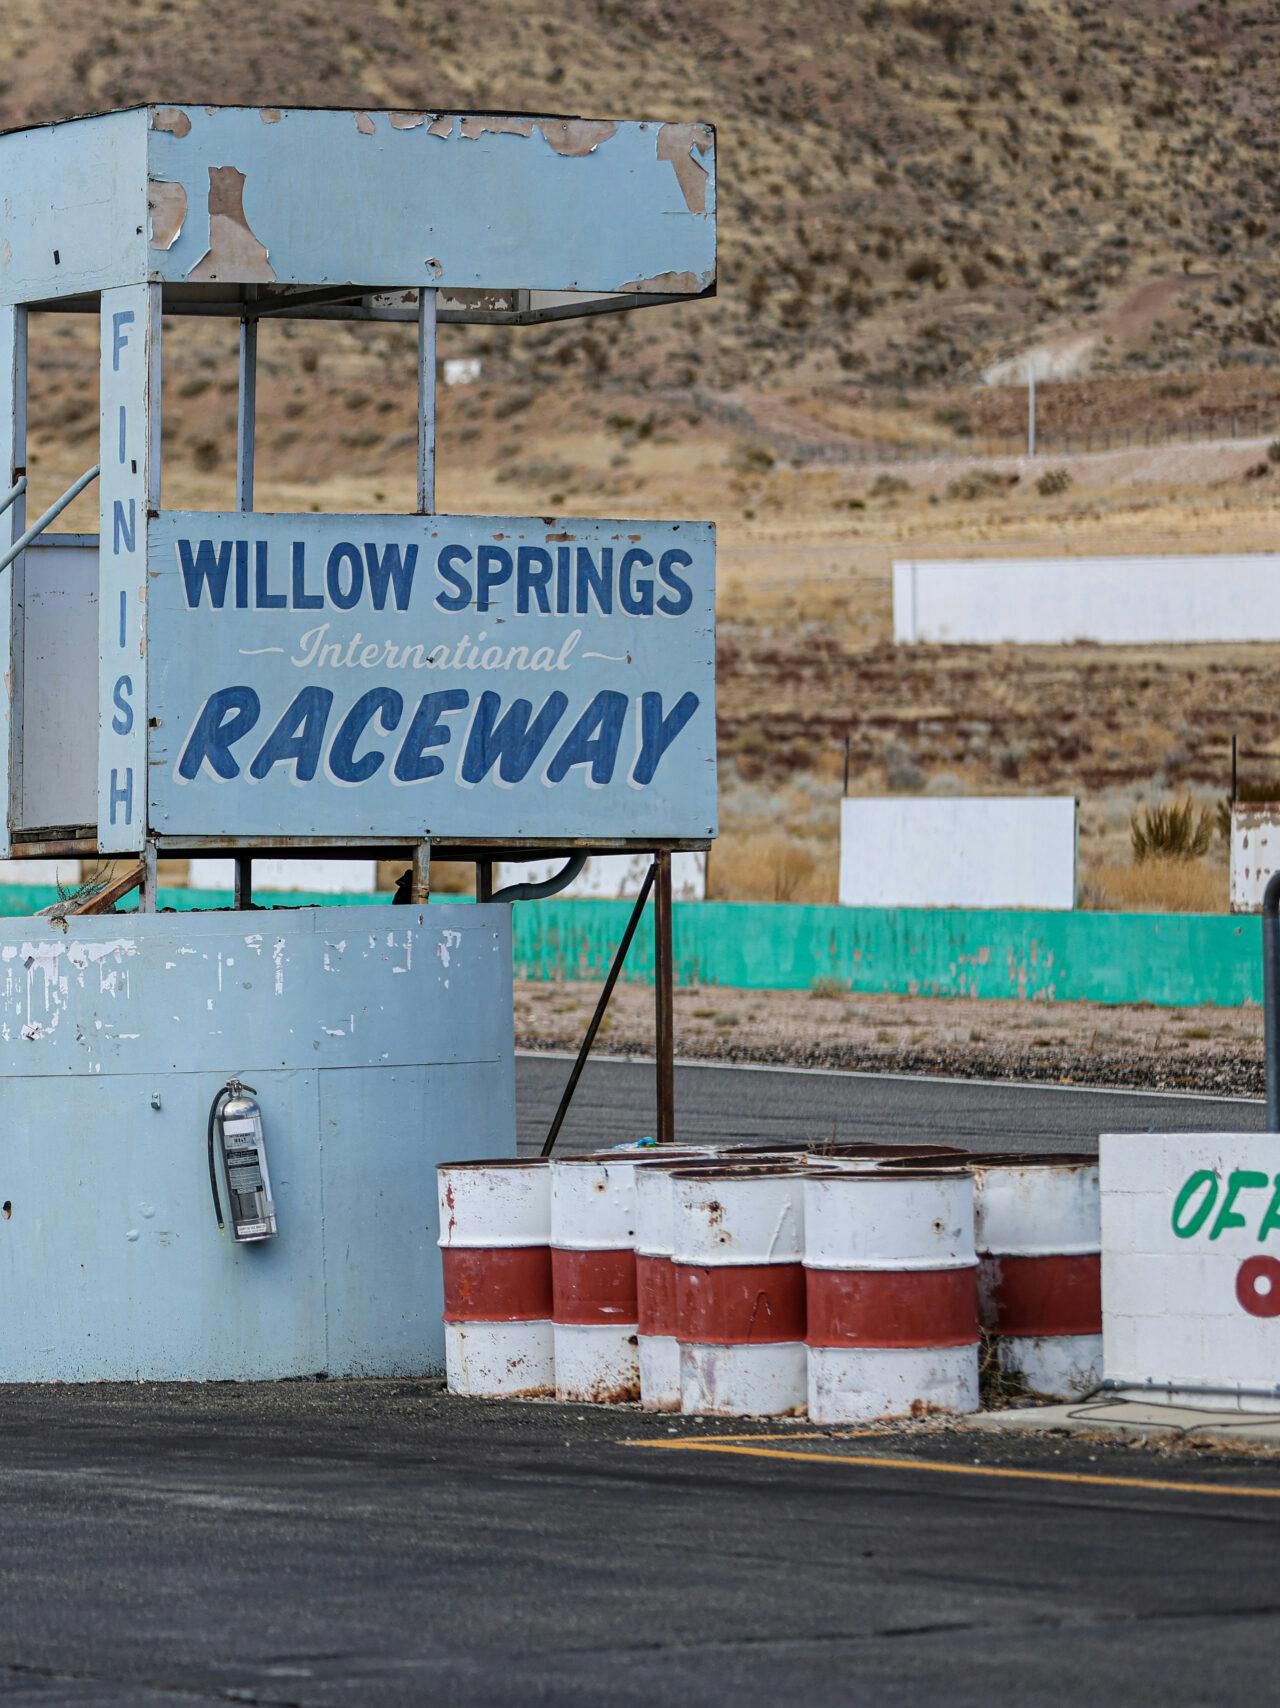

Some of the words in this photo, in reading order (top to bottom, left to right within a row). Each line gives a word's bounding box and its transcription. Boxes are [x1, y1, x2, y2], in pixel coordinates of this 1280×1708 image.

[109, 310, 136, 826] FINISH
[176, 539, 419, 612] WILLOW
[434, 544, 694, 617] SPRINGS
[290, 623, 582, 671] International
[175, 685, 700, 789] RACEWAY
